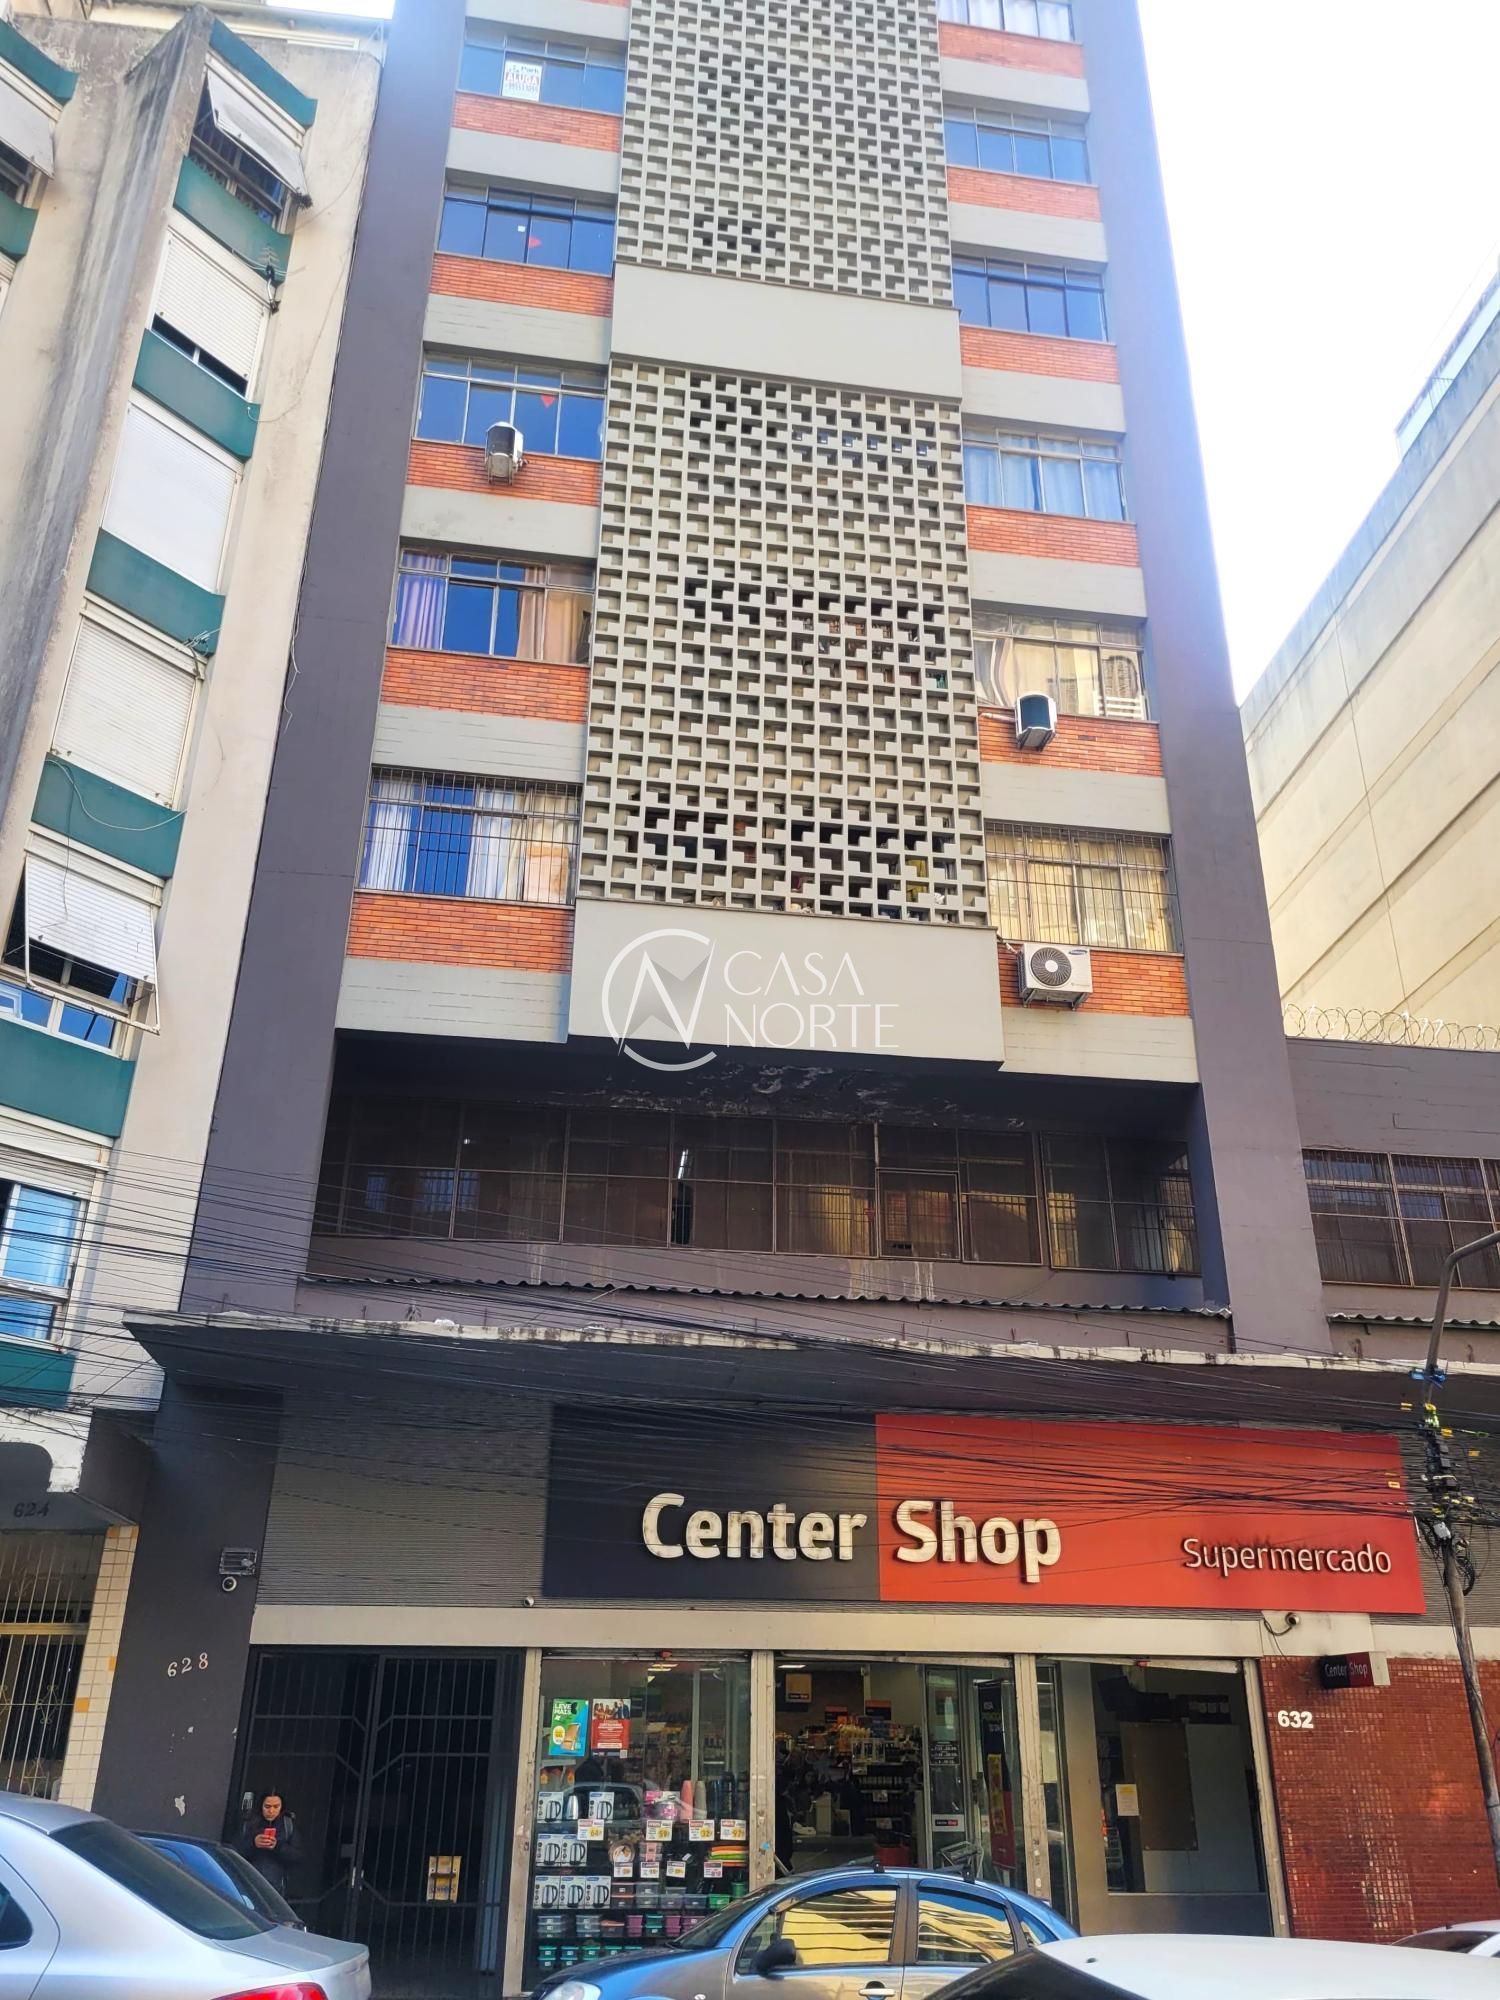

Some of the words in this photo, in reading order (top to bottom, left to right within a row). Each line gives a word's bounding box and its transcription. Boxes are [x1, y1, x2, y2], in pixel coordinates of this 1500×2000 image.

[14, 1501, 50, 1518] 624
[642, 1492, 868, 1561] Center
[895, 1498, 1062, 1584] Shop
[1182, 1537, 1393, 1577] Supermercado
[167, 1651, 209, 1678] 628
[1324, 1663, 1347, 1677] Center
[1348, 1660, 1369, 1678] Shop
[1277, 1709, 1314, 1729] 632
